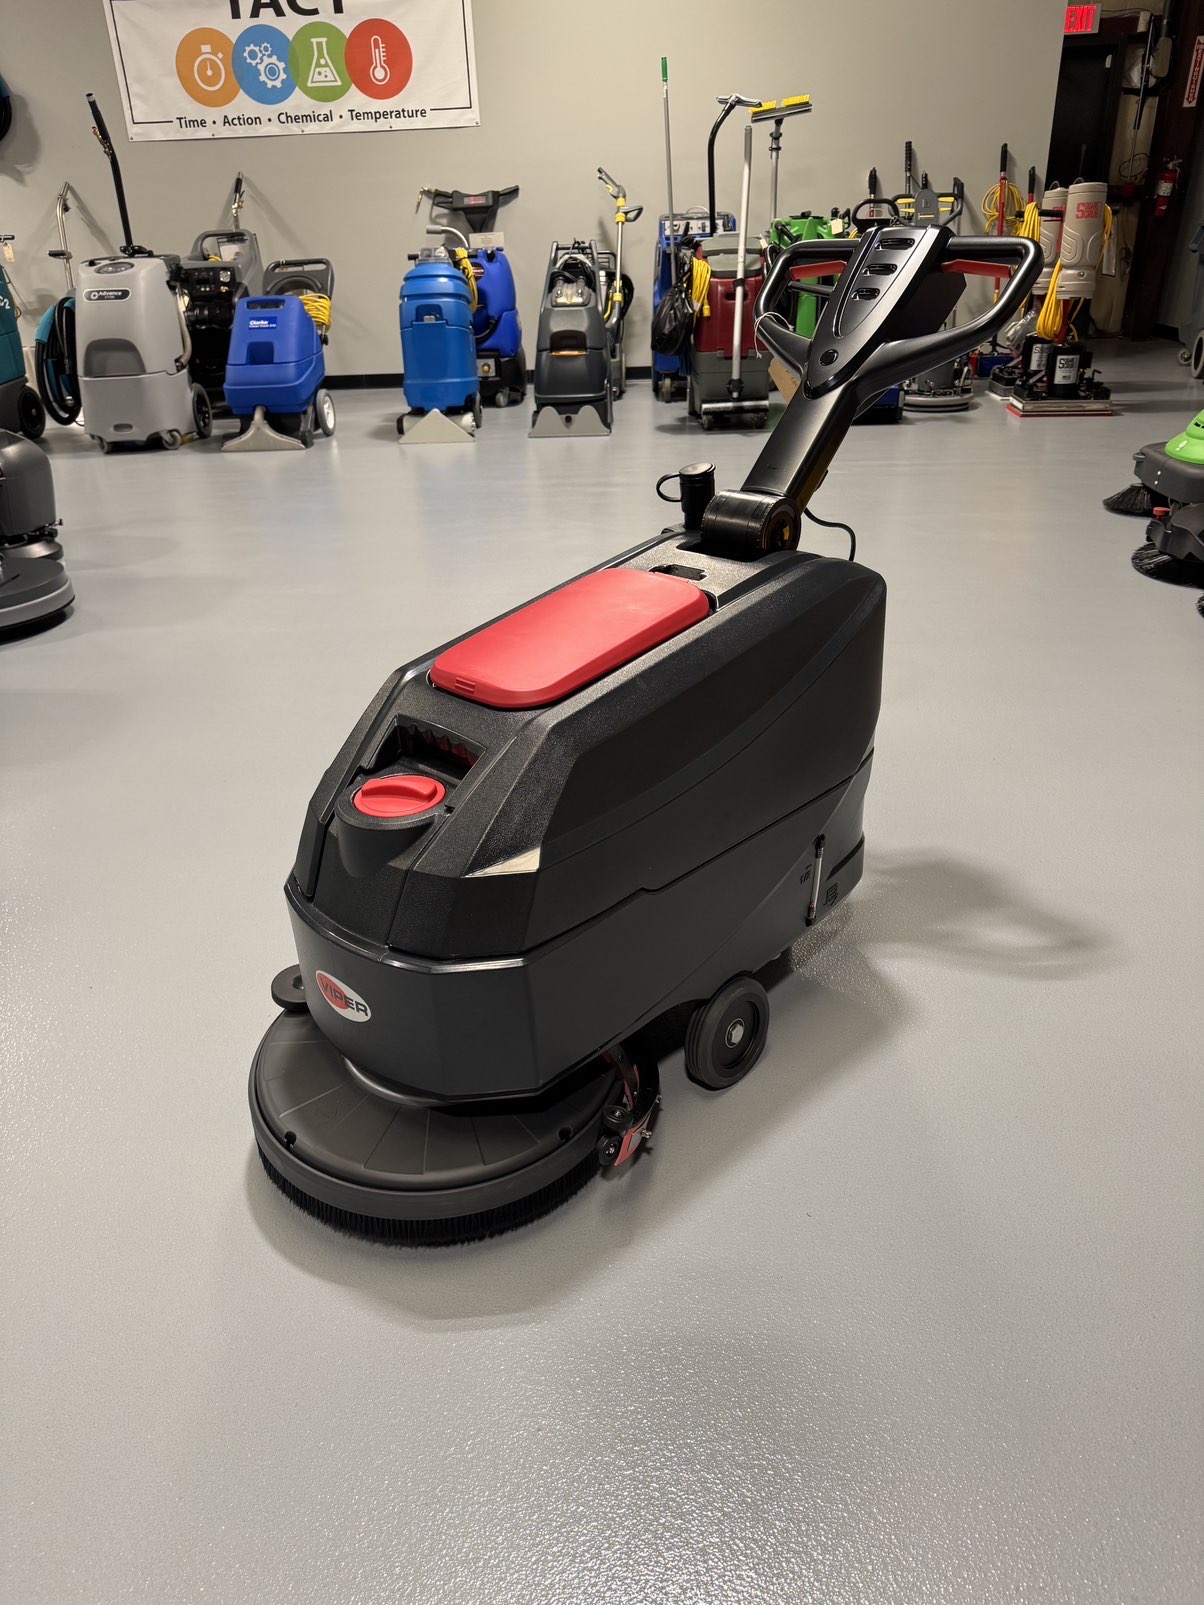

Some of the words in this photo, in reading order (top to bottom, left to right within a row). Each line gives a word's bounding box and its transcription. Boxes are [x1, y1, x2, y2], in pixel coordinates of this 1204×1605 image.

[1065, 5, 1097, 33] EXIT
[176, 116, 207, 129] Time
[223, 114, 262, 127] Action
[277, 110, 333, 124] Chemical
[348, 108, 427, 122] Temperature
[320, 977, 369, 1017] VIPER
